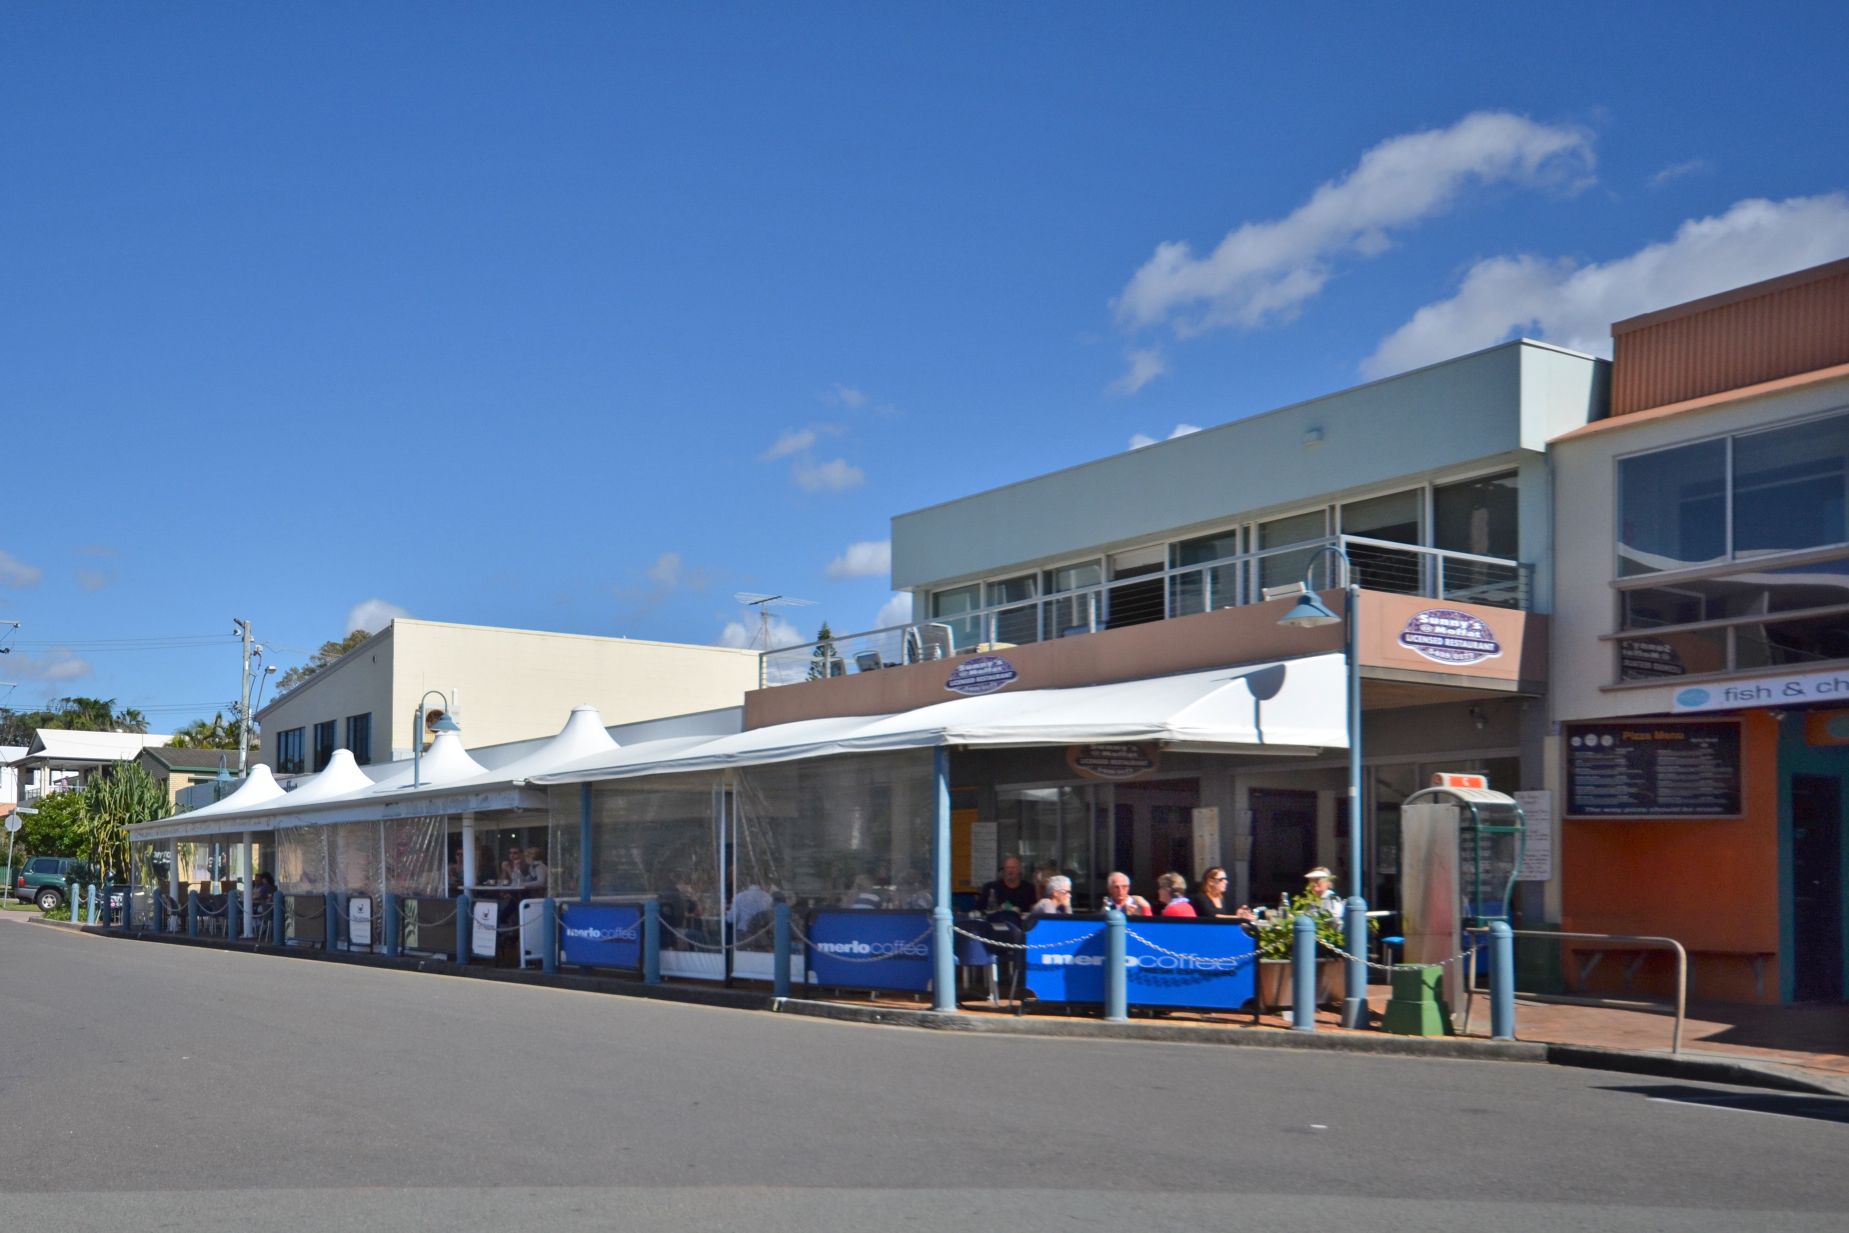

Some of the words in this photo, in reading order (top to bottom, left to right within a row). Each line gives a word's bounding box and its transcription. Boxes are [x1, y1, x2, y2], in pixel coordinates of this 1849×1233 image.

[1419, 614, 1482, 629] Sunny's
[1434, 626, 1482, 638] Moffat
[1405, 634, 1444, 645] LICENSED
[1445, 638, 1495, 651] RESTAURANT
[1724, 685, 1772, 702] fish
[1782, 681, 1805, 697] &
[1815, 678, 1849, 694] ch
[1622, 731, 1652, 741] Pizza
[1653, 731, 1685, 740] Menu
